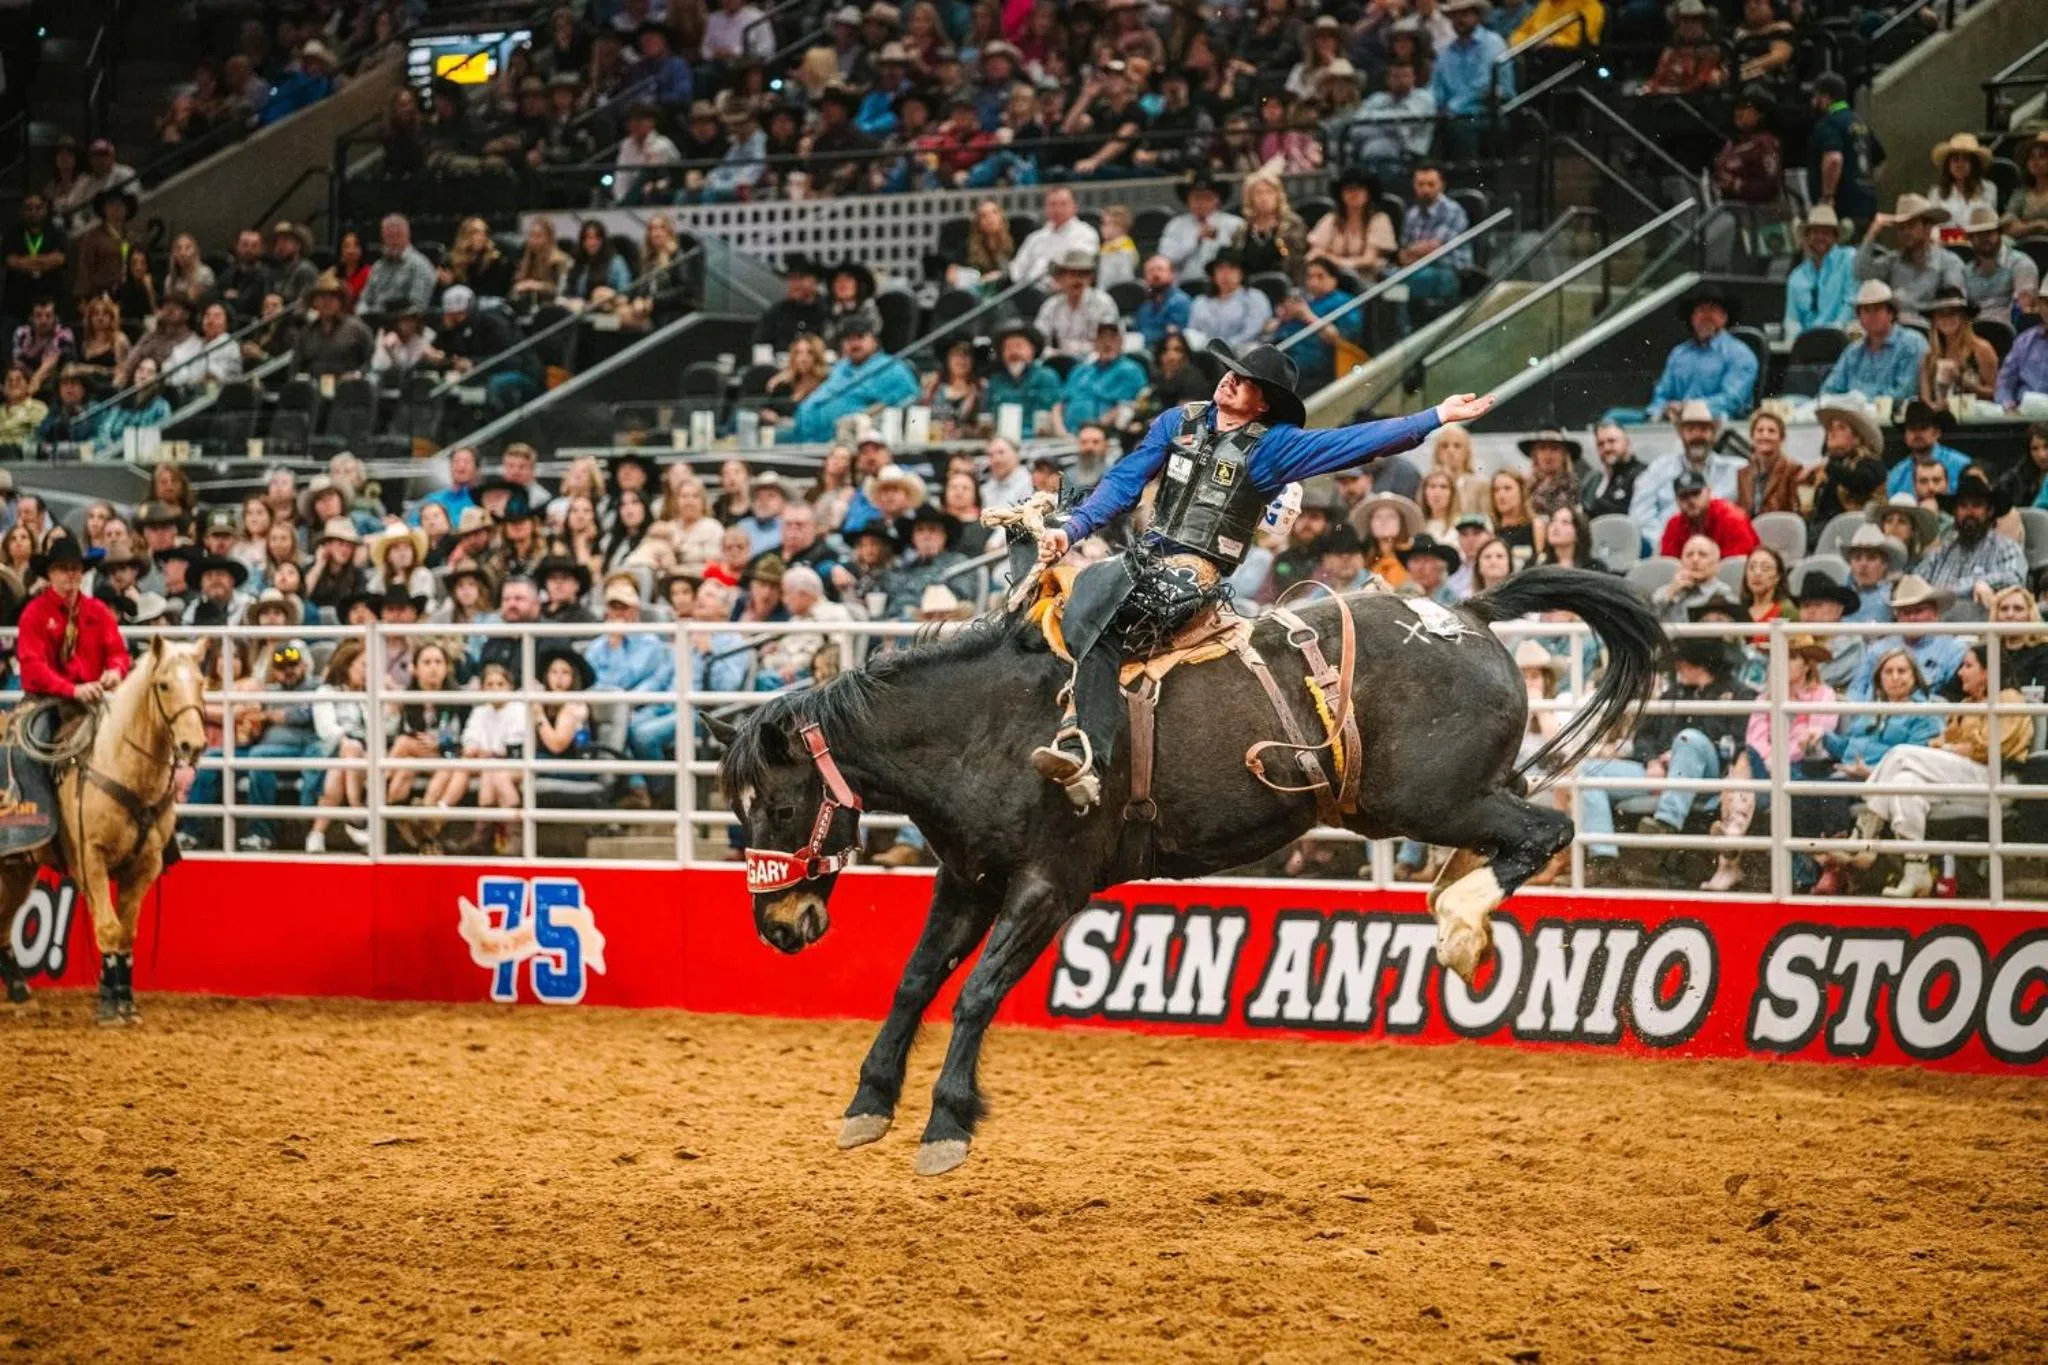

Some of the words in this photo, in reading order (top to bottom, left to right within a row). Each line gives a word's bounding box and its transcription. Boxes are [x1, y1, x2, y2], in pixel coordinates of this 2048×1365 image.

[479, 876, 587, 1003] 75
[1050, 906, 1246, 1016] SAN
[1247, 916, 1713, 1037] ANTONIO
[1751, 931, 2048, 1054] STOC
